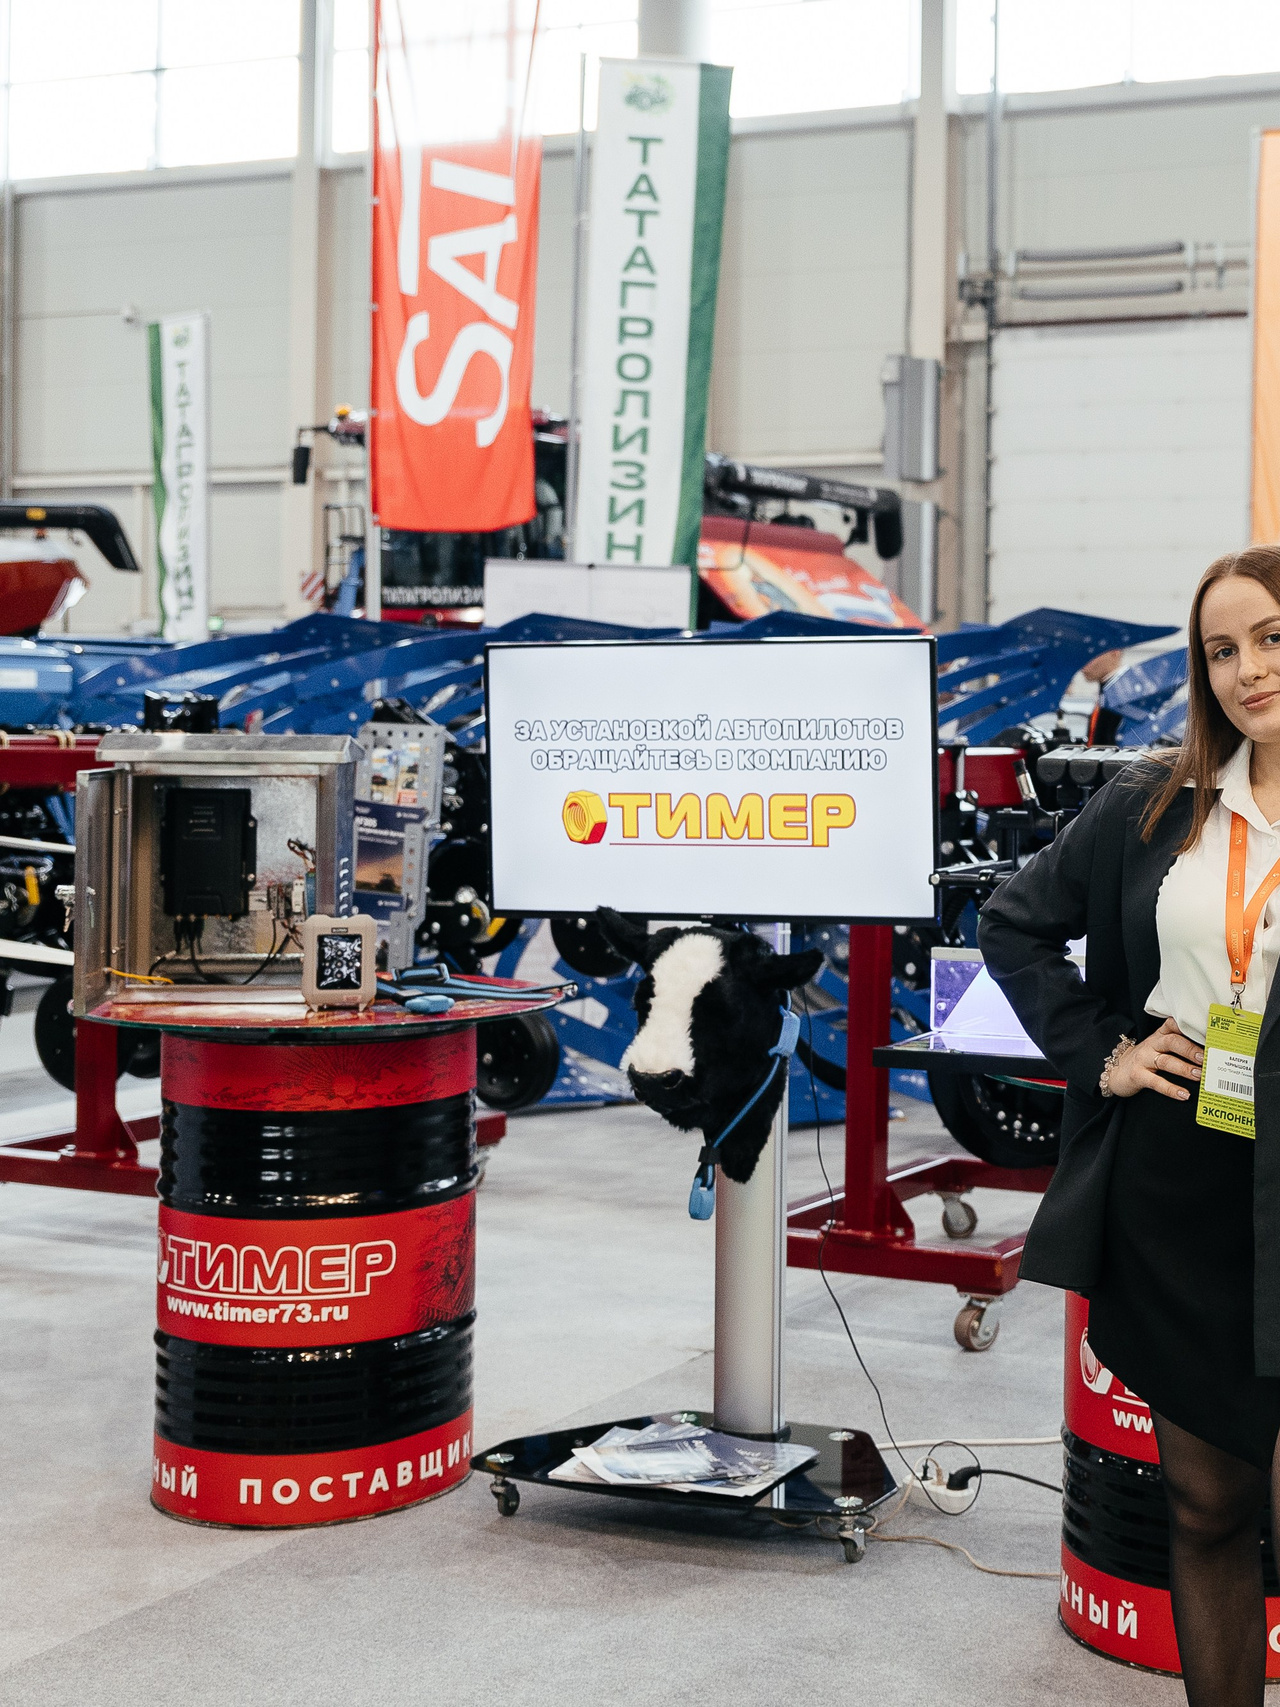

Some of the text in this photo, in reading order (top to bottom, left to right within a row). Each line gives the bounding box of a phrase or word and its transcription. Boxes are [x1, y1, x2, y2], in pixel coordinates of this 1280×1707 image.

[606, 136, 663, 563] ТАТАГРОЛИЗИН
[515, 714, 904, 741] ЗА УСТАНОВКОЙ АВТОПИЛОТОВ
[531, 744, 888, 773] ОБРАЩАЙТЕСЬ В КОМПАНИЮ
[608, 792, 857, 847] ТИМЕР
[168, 1235, 396, 1296] ТИМЕР
[166, 1295, 349, 1323] www.timer73.ru
[239, 1431, 471, 1505] ПОСТАВЩИК
